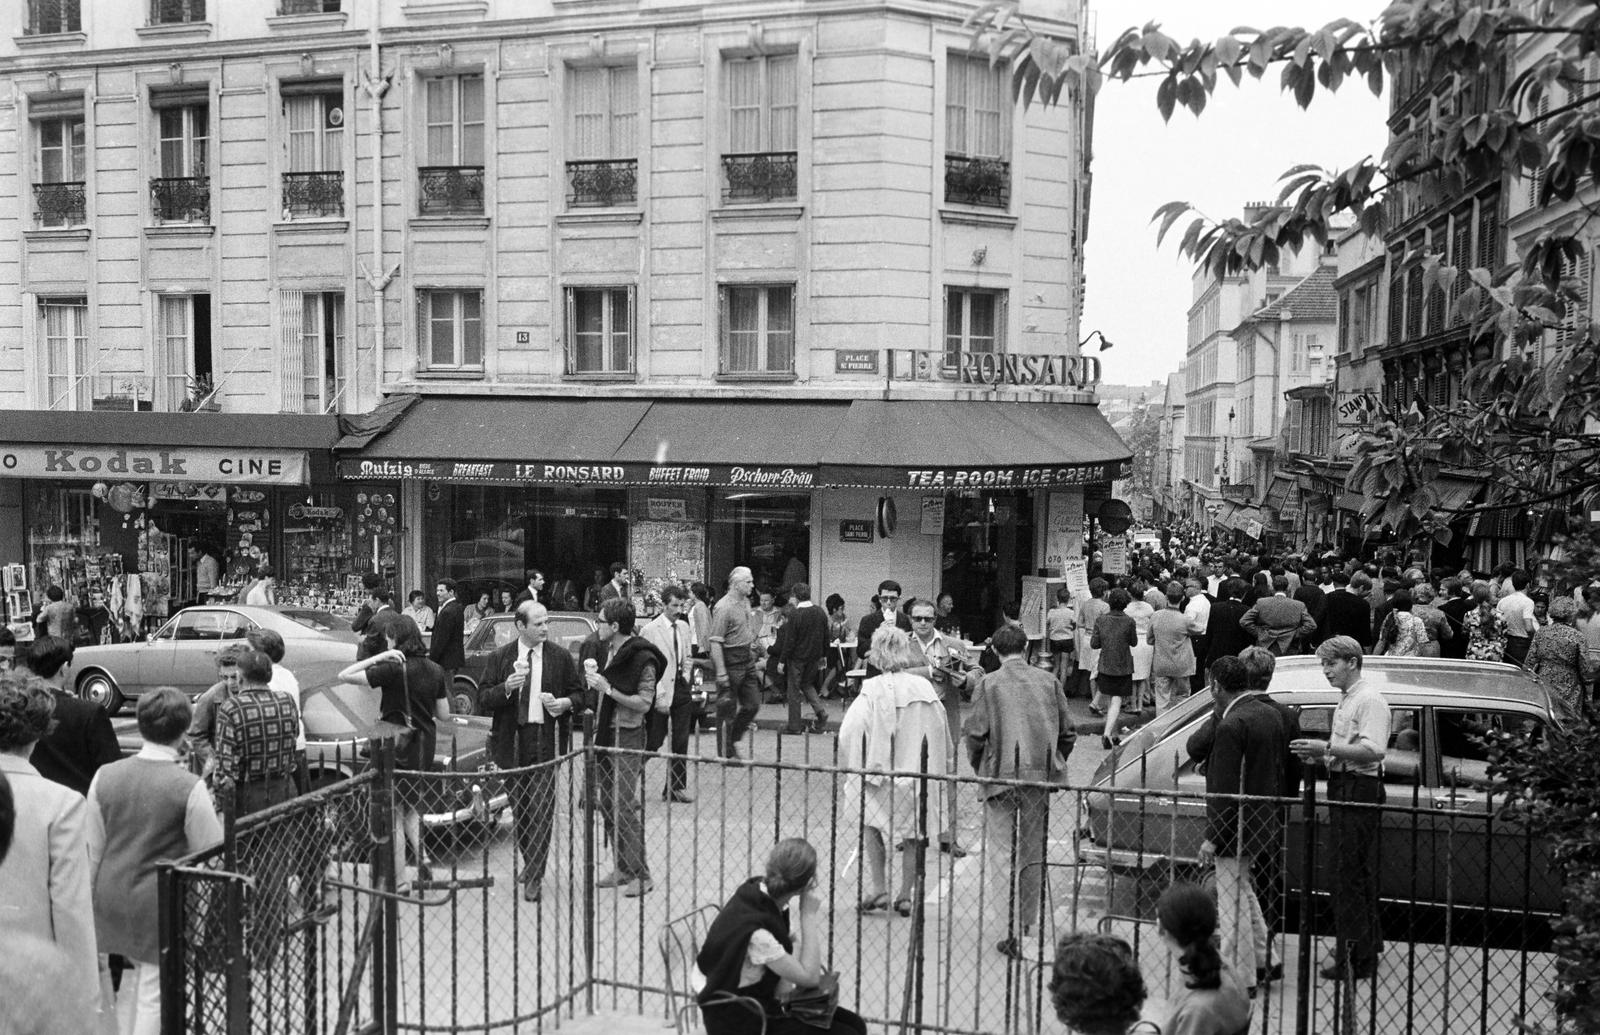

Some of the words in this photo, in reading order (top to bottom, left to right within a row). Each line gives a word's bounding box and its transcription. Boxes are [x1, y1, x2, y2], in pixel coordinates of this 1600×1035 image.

[518, 333, 528, 342] 13
[887, 349, 931, 381] LE
[959, 352, 1101, 386] RONSARD
[44, 450, 187, 474] Kodak
[218, 458, 282, 475] CINE
[360, 460, 412, 476] Mutzig
[453, 463, 494, 477] BREAKFAST
[515, 464, 535, 479] LE
[544, 465, 625, 480] RONSARD
[649, 467, 682, 481] BUFFET
[682, 467, 710, 482] FROID
[730, 466, 813, 485] Pschorr-Bräu
[907, 470, 1014, 486] TEA-ROOM
